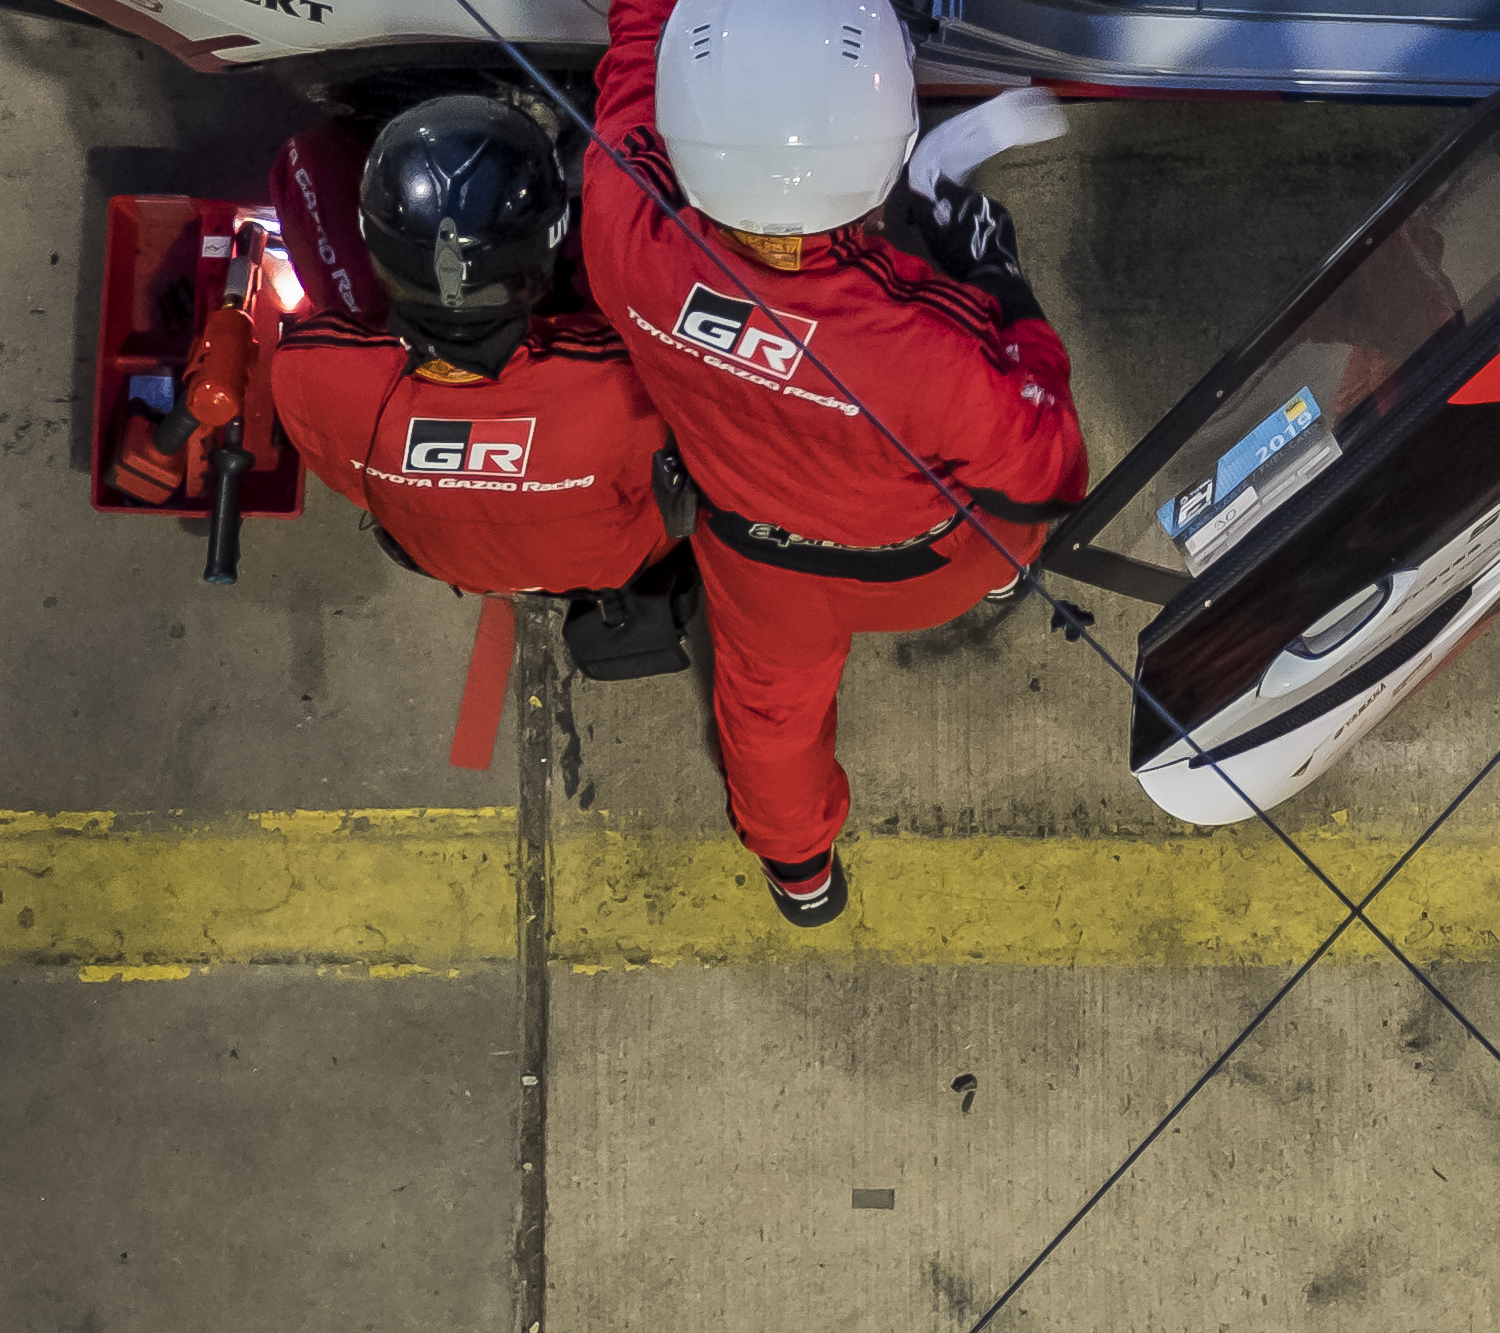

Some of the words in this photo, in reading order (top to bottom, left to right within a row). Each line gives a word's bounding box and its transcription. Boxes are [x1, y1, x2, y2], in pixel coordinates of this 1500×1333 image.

[627, 305, 701, 358] TOYOTA
[782, 385, 861, 417] Racing
[683, 312, 797, 373] GR
[410, 442, 524, 473] GR
[1254, 409, 1314, 463] 2019
[437, 477, 517, 492] GAZOO
[520, 473, 596, 493] Racing
